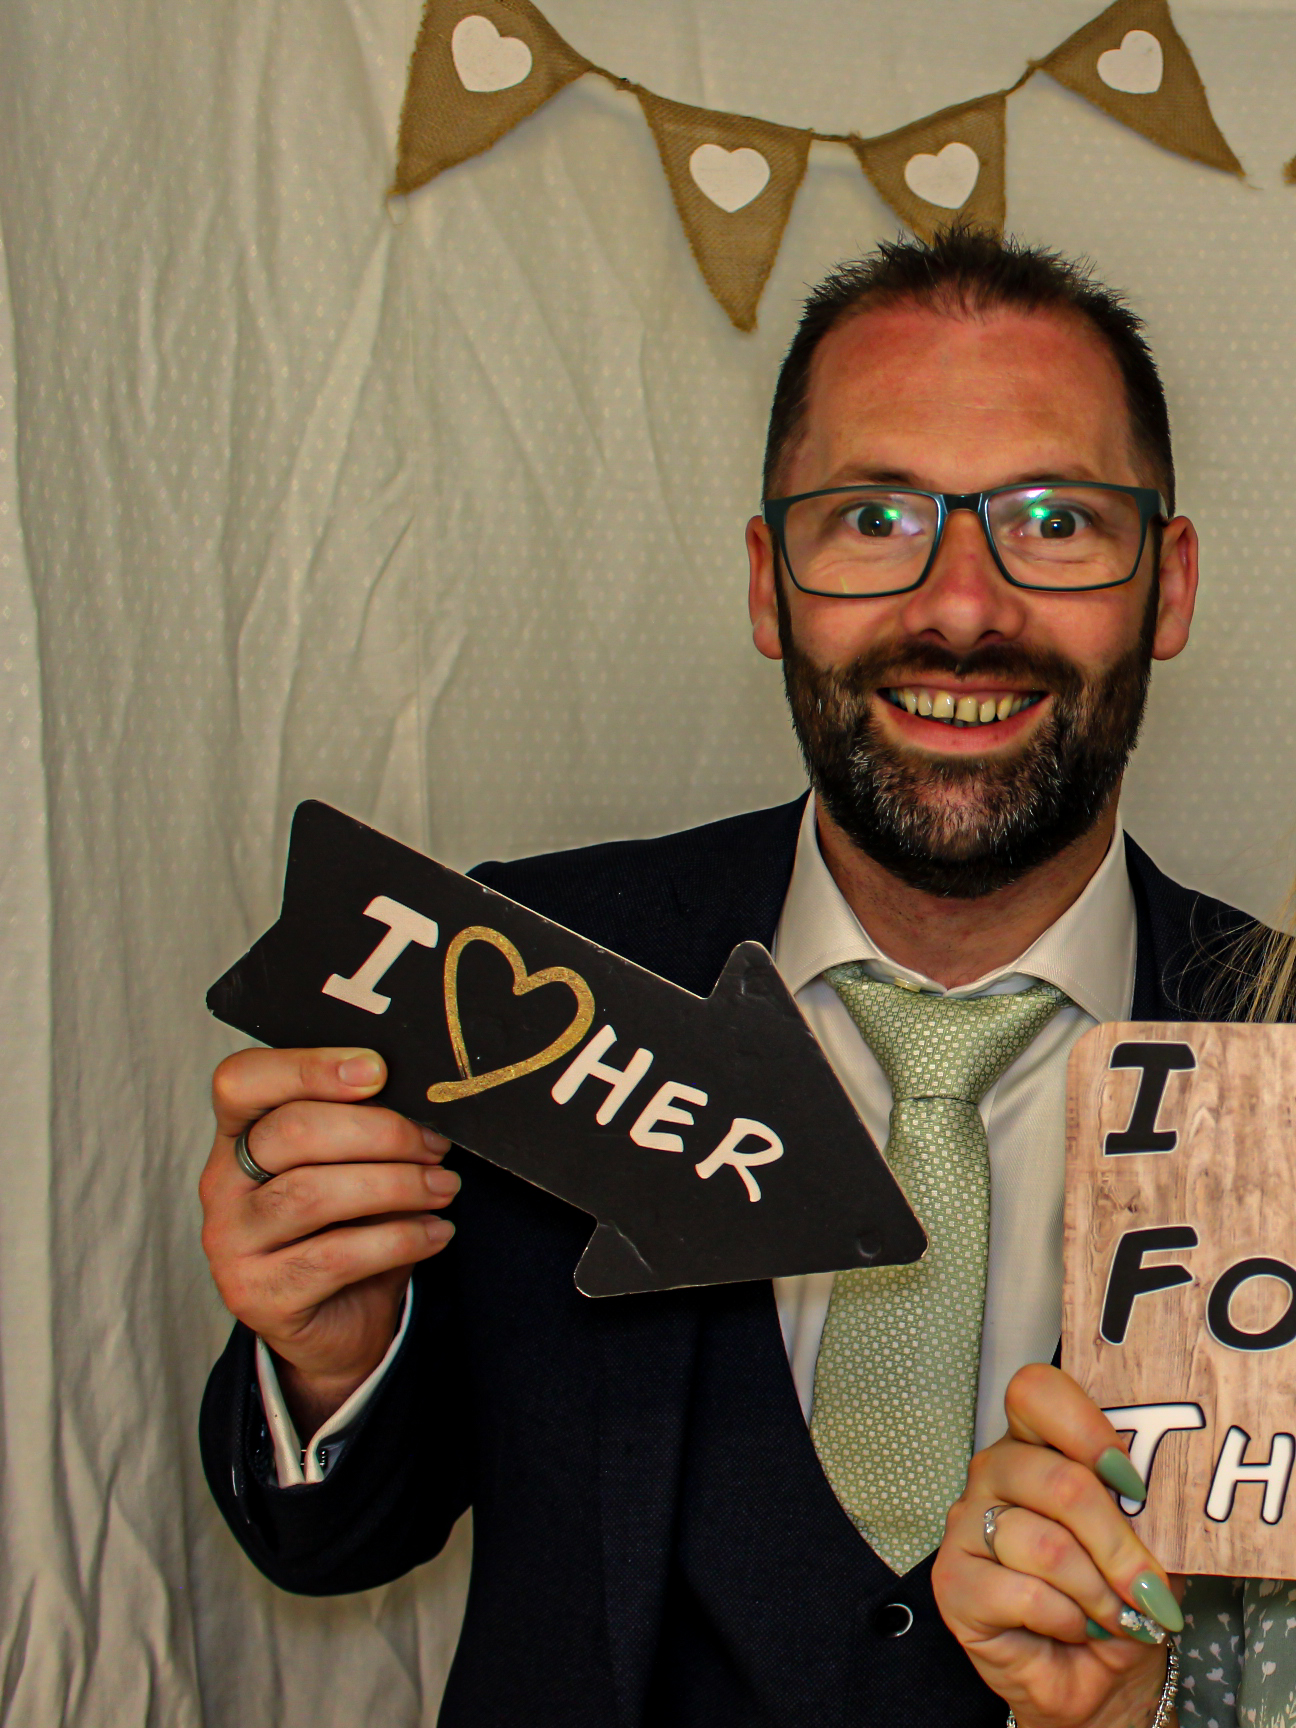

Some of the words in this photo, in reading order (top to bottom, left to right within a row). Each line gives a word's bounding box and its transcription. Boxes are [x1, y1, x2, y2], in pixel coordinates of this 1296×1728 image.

[322, 895, 438, 1015] I
[552, 1024, 784, 1202] HER
[1103, 1041, 1197, 1157] I
